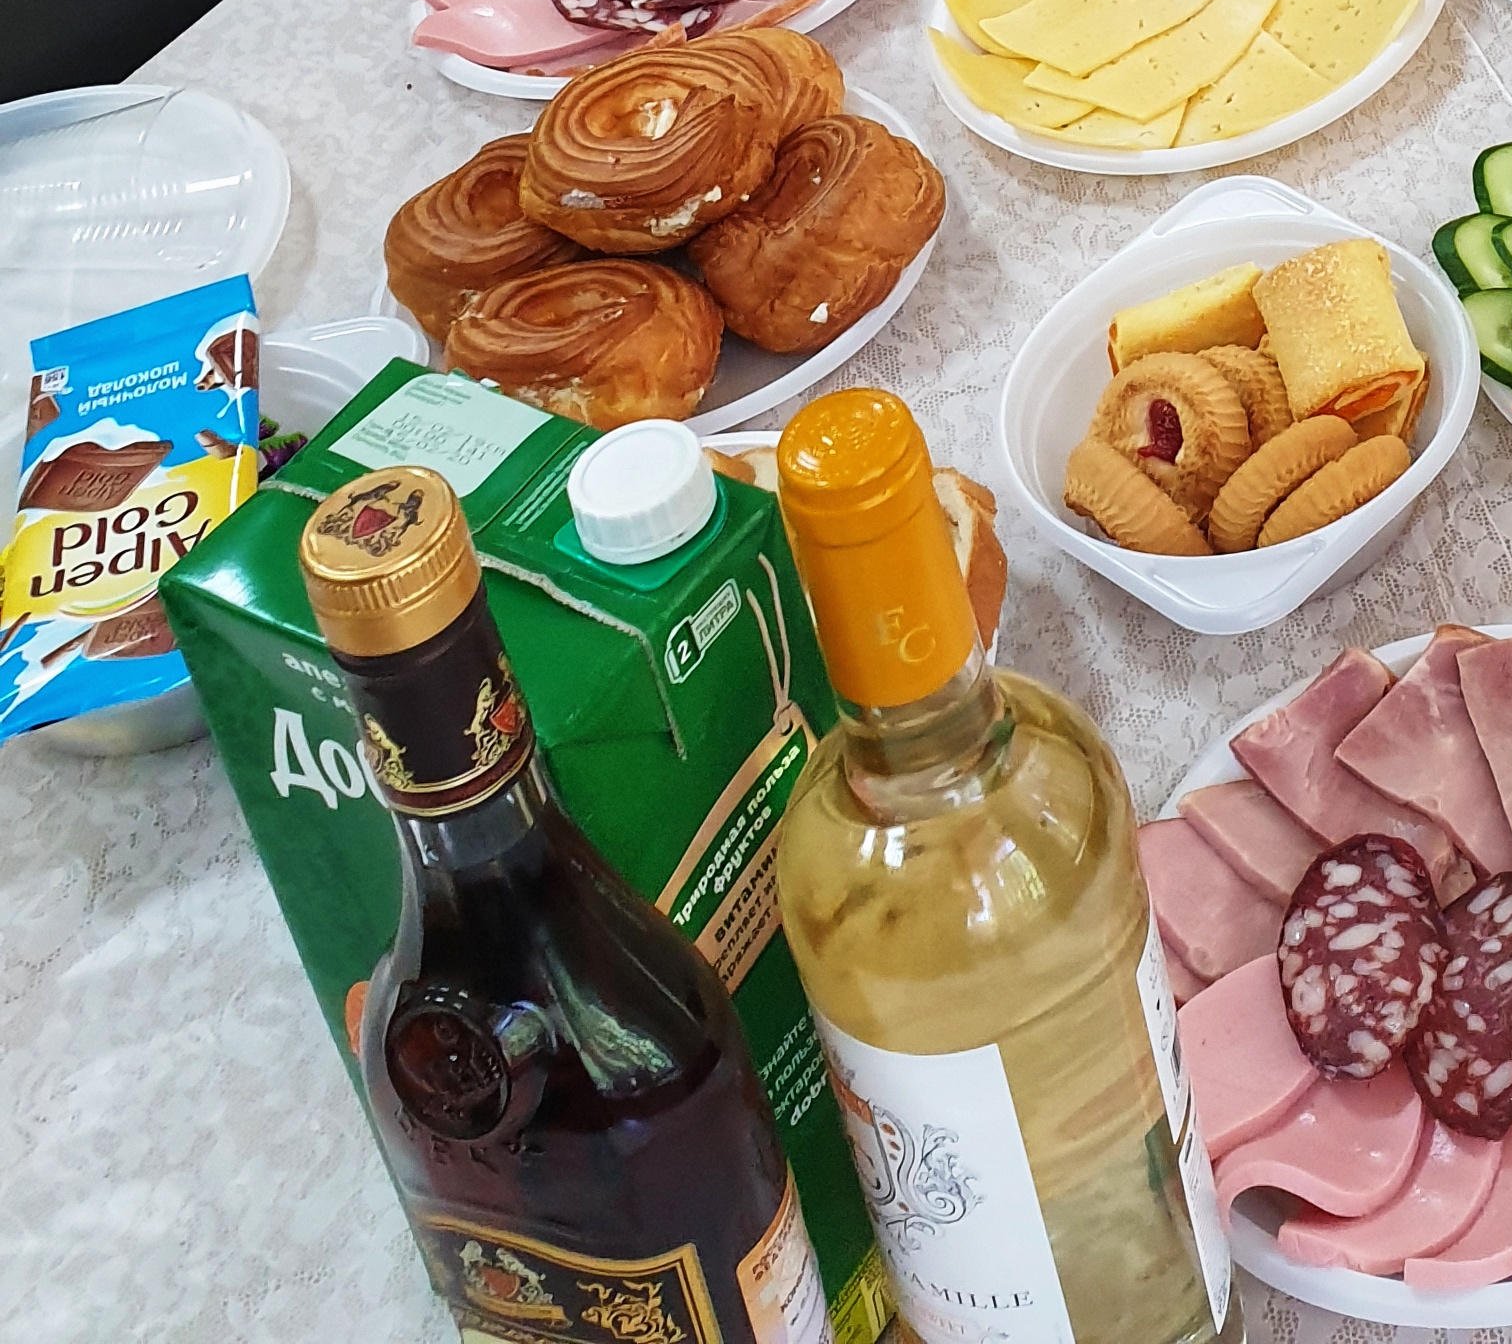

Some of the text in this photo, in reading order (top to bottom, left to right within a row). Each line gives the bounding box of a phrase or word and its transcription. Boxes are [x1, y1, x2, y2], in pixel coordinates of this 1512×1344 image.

[78, 372, 188, 417] Молочный
[30, 517, 213, 599] Alpen
[52, 490, 200, 568] Gold
[281, 652, 348, 690] апе
[677, 639, 692, 666] 2
[746, 744, 801, 816] польза
[713, 804, 773, 895] фруктов
[904, 1269, 1034, 1310] AMILLE
